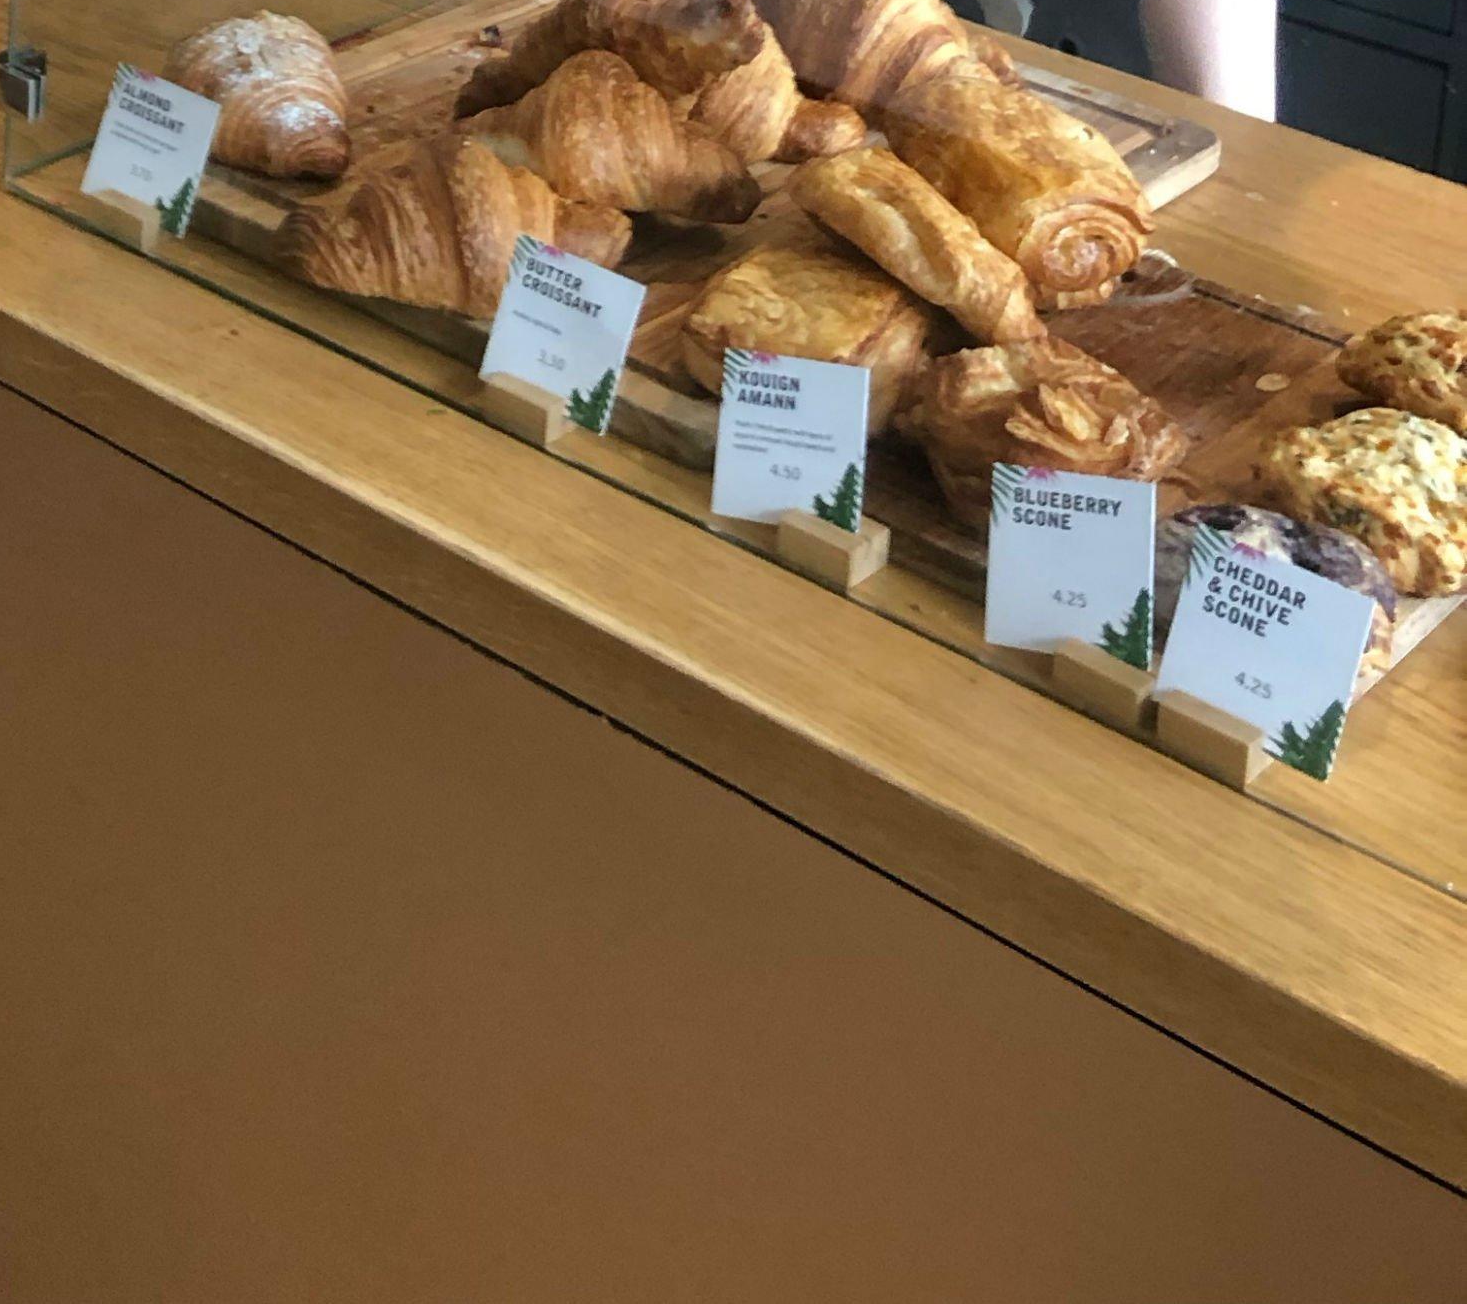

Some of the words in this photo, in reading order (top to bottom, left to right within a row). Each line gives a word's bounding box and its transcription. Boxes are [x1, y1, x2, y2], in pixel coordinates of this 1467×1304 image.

[123, 83, 172, 112] ALMOND
[119, 97, 186, 134] CROISSANT
[526, 256, 583, 291] BUTTER
[522, 273, 602, 318] CROISSANT
[738, 370, 801, 393] KOUIGN
[737, 388, 796, 410] AMANN
[1013, 486, 1122, 517] BLUEBERRY
[1012, 506, 1072, 531] SCONE
[1214, 555, 1306, 610] CHEDDAR
[1052, 589, 1087, 609] 4.25
[1208, 575, 1222, 594] &
[1228, 584, 1293, 626] CHIVE
[1203, 594, 1269, 638] SCONE
[1234, 671, 1274, 700] 4.25
